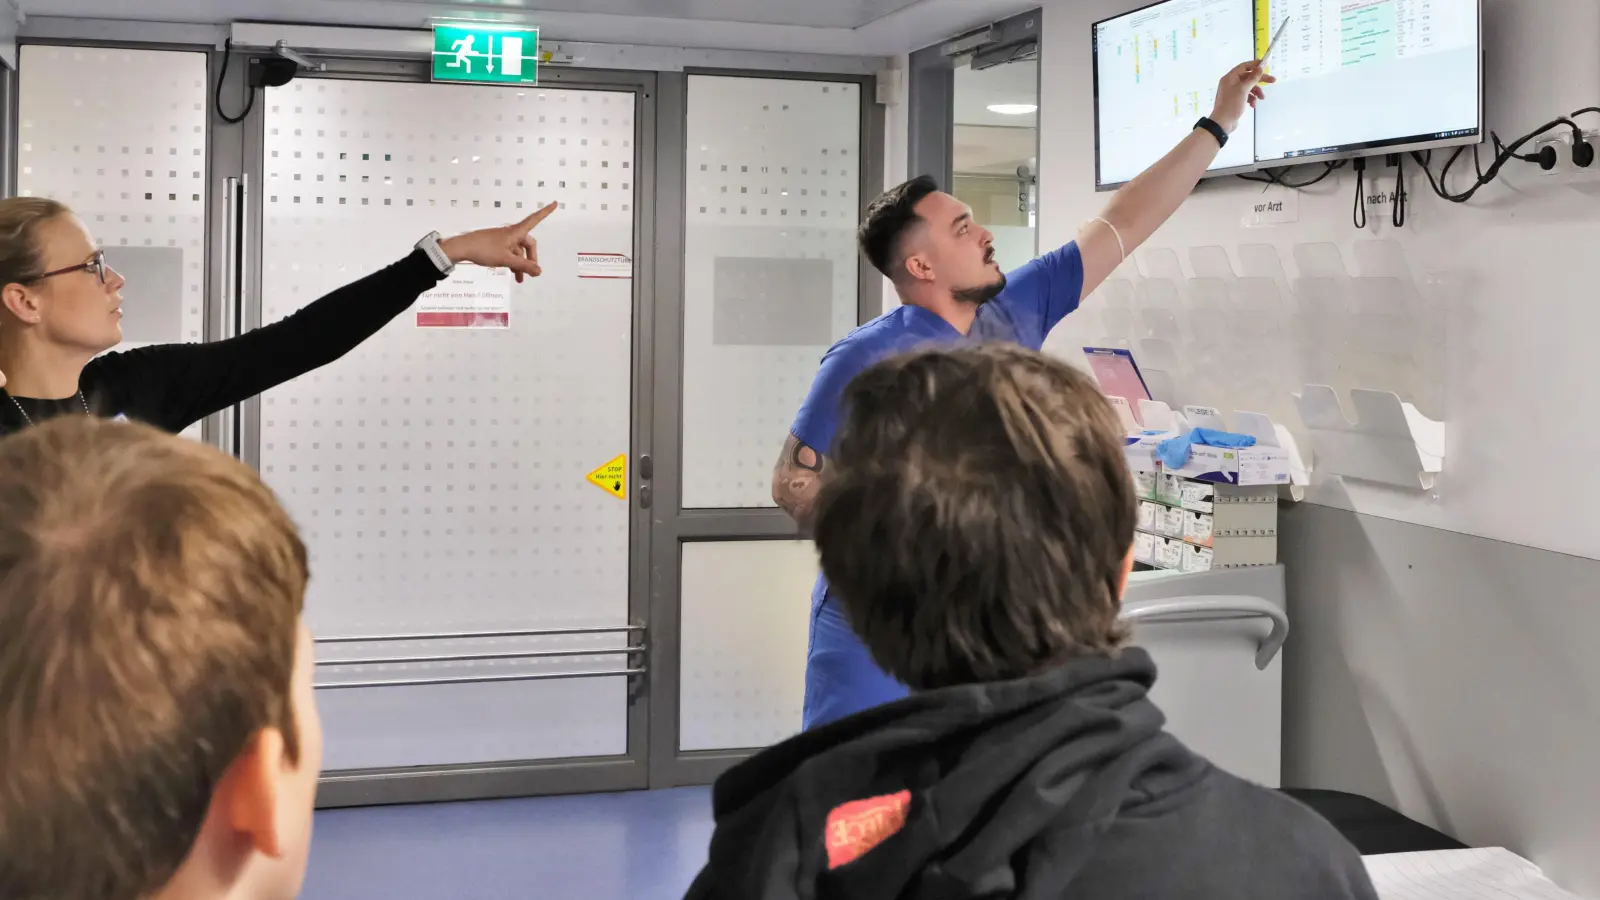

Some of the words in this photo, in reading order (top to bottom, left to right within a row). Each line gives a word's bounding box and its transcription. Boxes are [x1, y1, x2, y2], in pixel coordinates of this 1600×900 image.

[1366, 192, 1387, 205] nach
[1389, 191, 1407, 203] At
[1254, 204, 1266, 213] vor
[1267, 201, 1283, 212] Arzt
